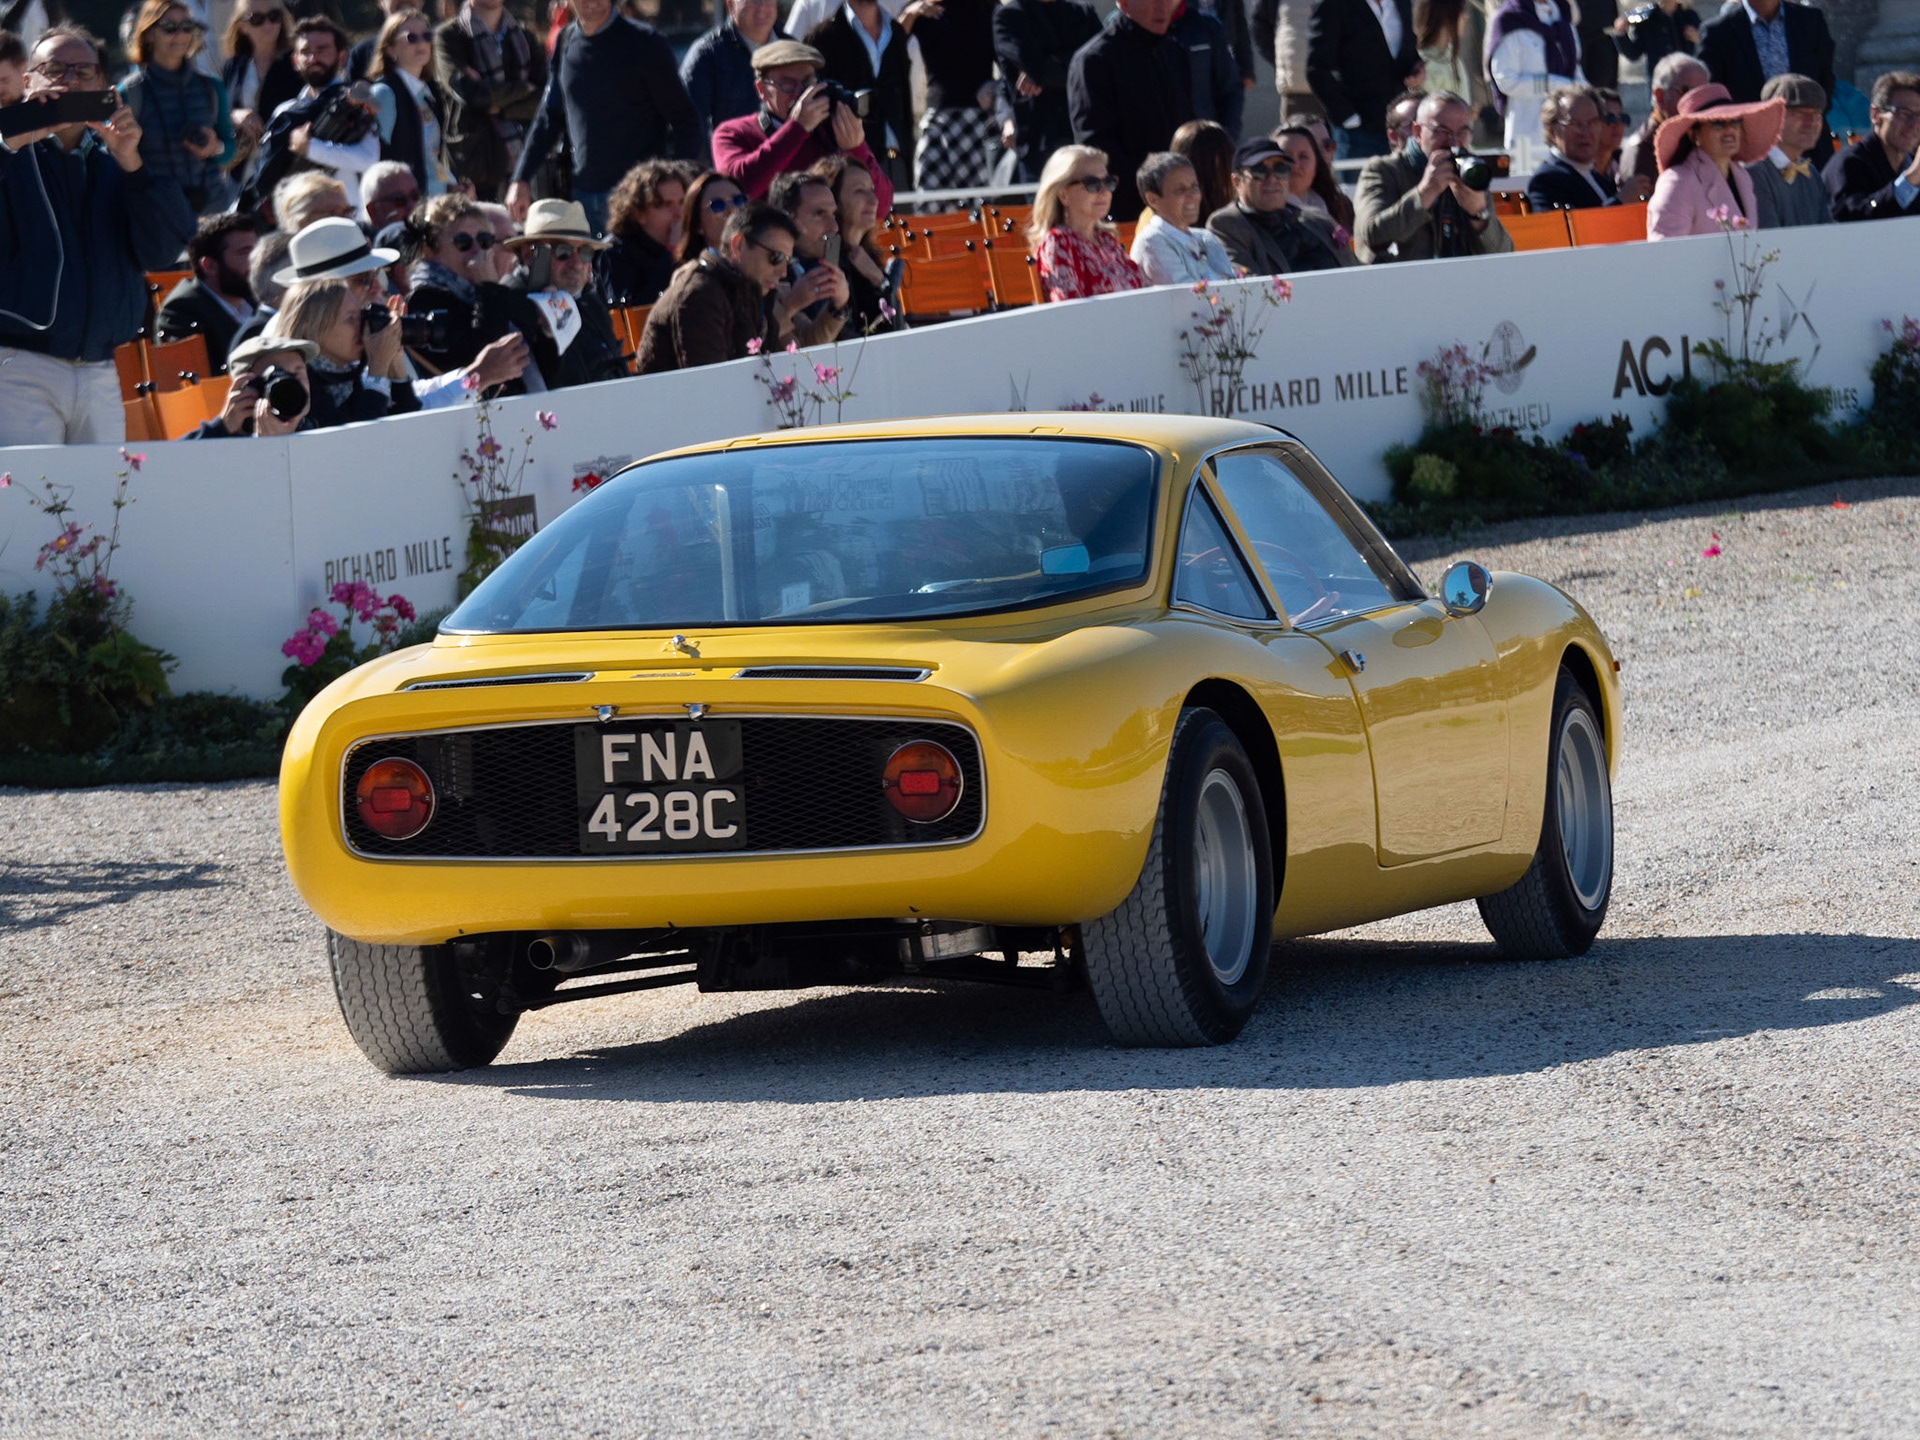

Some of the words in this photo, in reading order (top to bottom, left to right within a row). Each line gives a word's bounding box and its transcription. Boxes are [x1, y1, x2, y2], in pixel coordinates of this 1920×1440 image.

[1211, 377, 1320, 417] RICHARD
[1335, 366, 1409, 402] MILLE
[325, 547, 397, 595] RICHARD
[404, 536, 453, 577] MILLE
[602, 731, 716, 783] FNA
[587, 789, 738, 842] 428C
